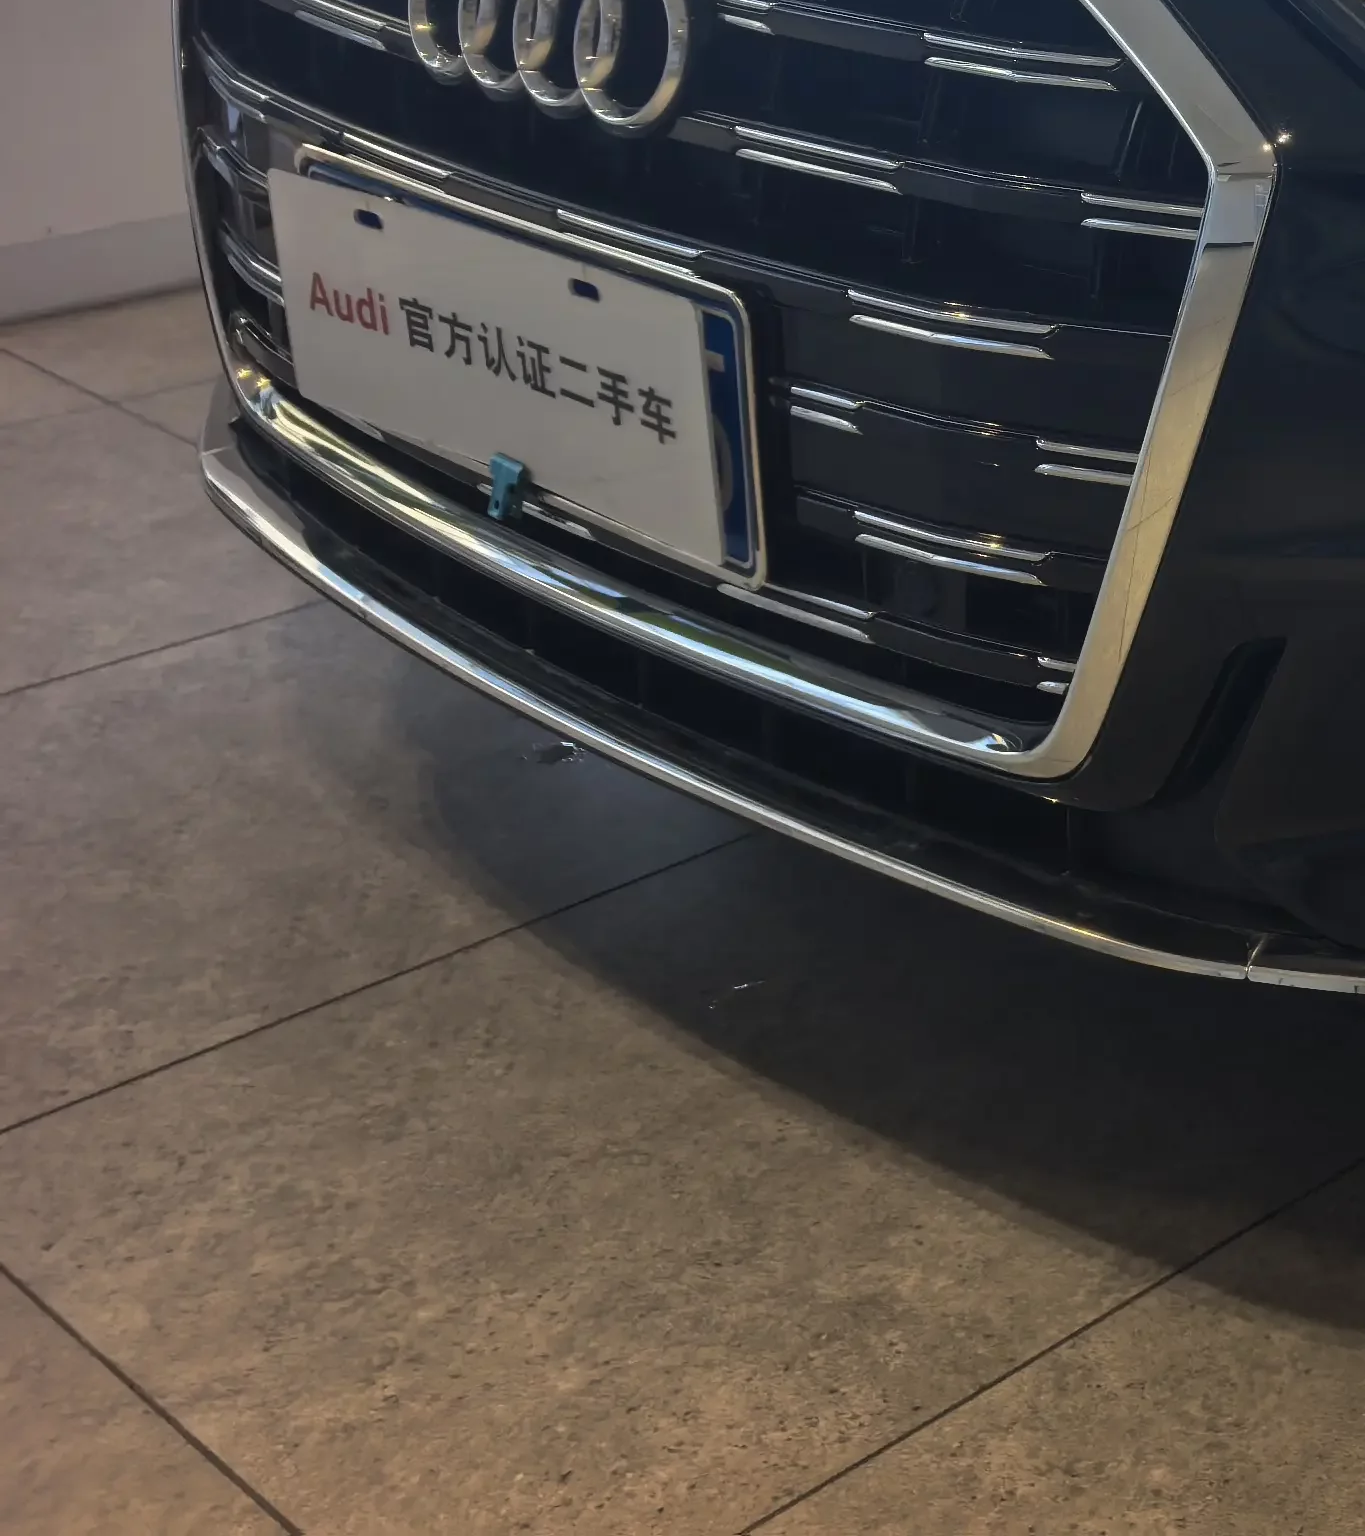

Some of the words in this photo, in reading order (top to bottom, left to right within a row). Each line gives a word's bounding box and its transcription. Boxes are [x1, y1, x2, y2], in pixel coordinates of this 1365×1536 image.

[309, 271, 390, 336] Audi
[399, 298, 677, 445] 官方认证二手车
